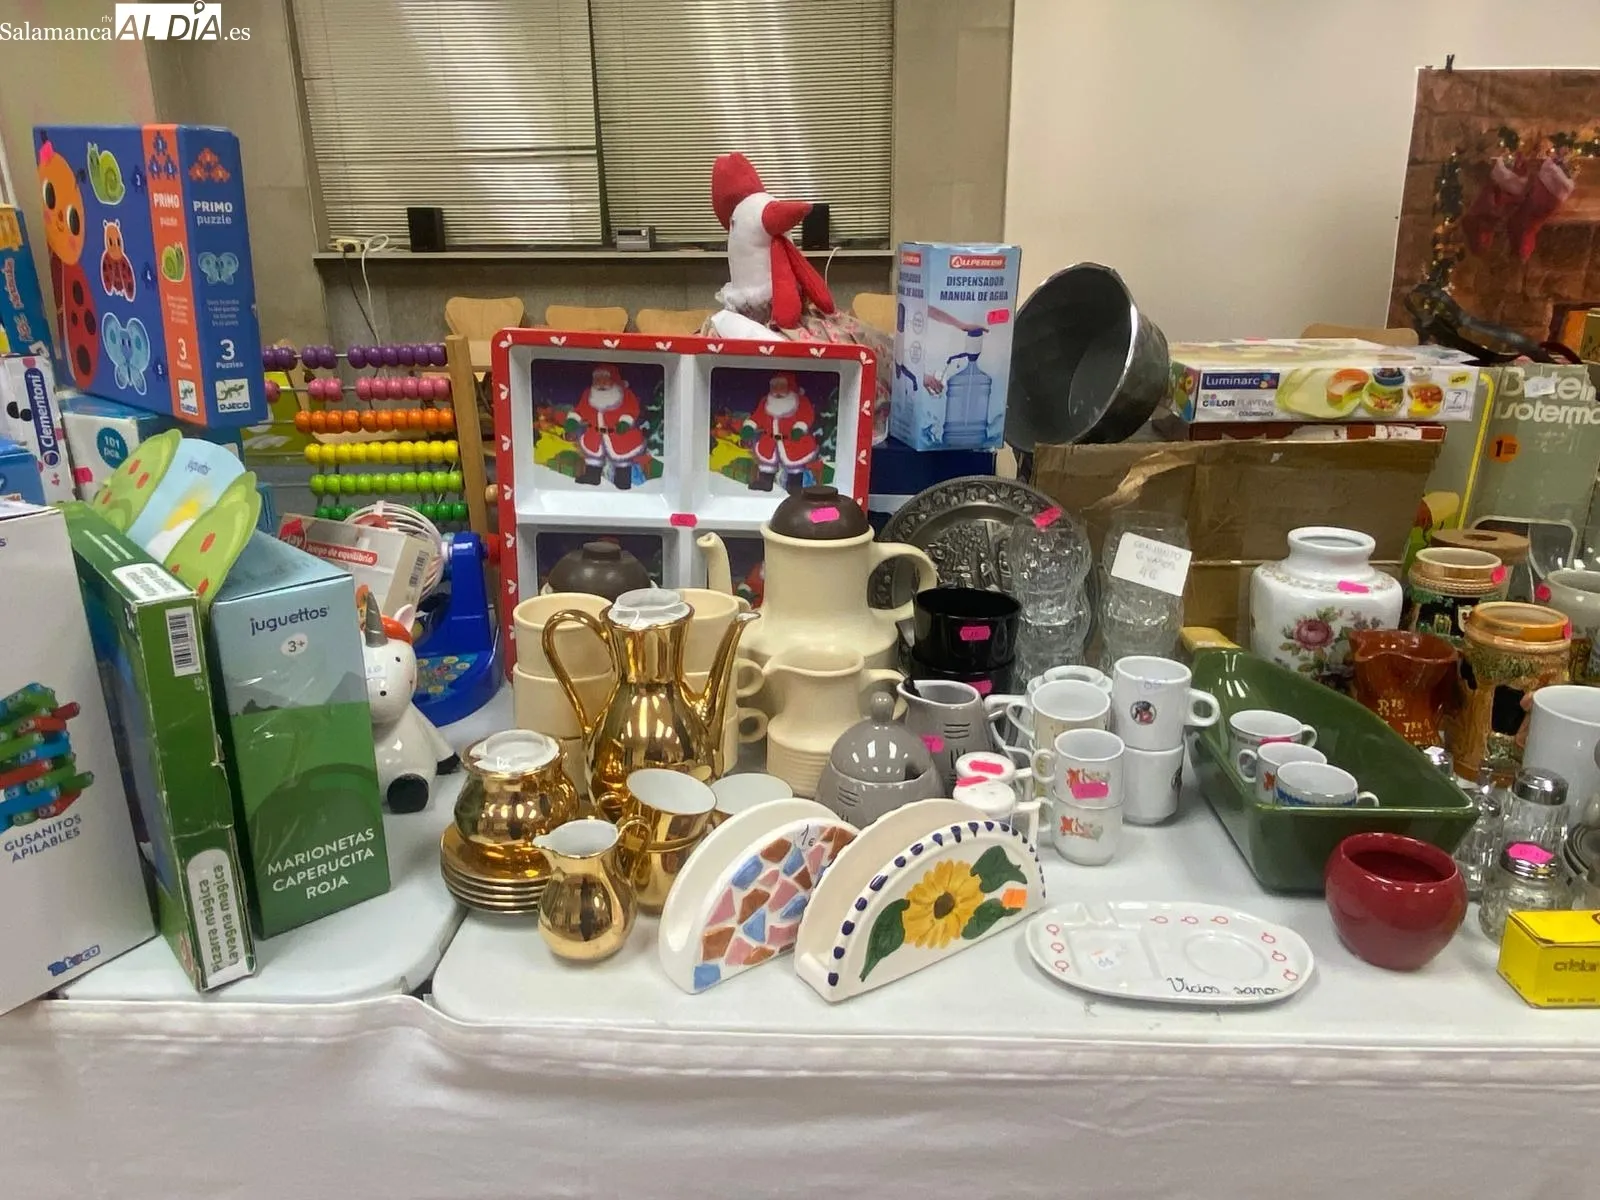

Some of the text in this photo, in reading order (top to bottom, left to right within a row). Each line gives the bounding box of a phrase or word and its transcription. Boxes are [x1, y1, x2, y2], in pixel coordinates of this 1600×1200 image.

[153, 193, 180, 209] PRIMO
[193, 200, 233, 212] PRIMO
[197, 215, 232, 226] puzzle
[946, 276, 1005, 287] DISPENSADOR
[940, 291, 1009, 301] MANUAL DE AGUA
[178, 337, 187, 361] 3
[220, 339, 235, 360] 3
[216, 361, 243, 369] Puzzles
[1205, 375, 1260, 386] Luminarc
[1454, 391, 1461, 404] 7
[28, 374, 54, 448] Clementoni
[104, 435, 120, 449] 101
[250, 606, 328, 636] juguettos
[288, 640, 305, 652] 3+
[4, 813, 82, 853] GUSANITOS
[12, 826, 81, 863] APILABLES
[267, 828, 375, 876] MARIONETAS
[272, 848, 375, 892] CAPERUCITA
[213, 864, 229, 911] magica
[306, 875, 349, 900] ROJA
[199, 879, 223, 973] Pizarra mágica
[1167, 977, 1283, 995] Vicios sanos
